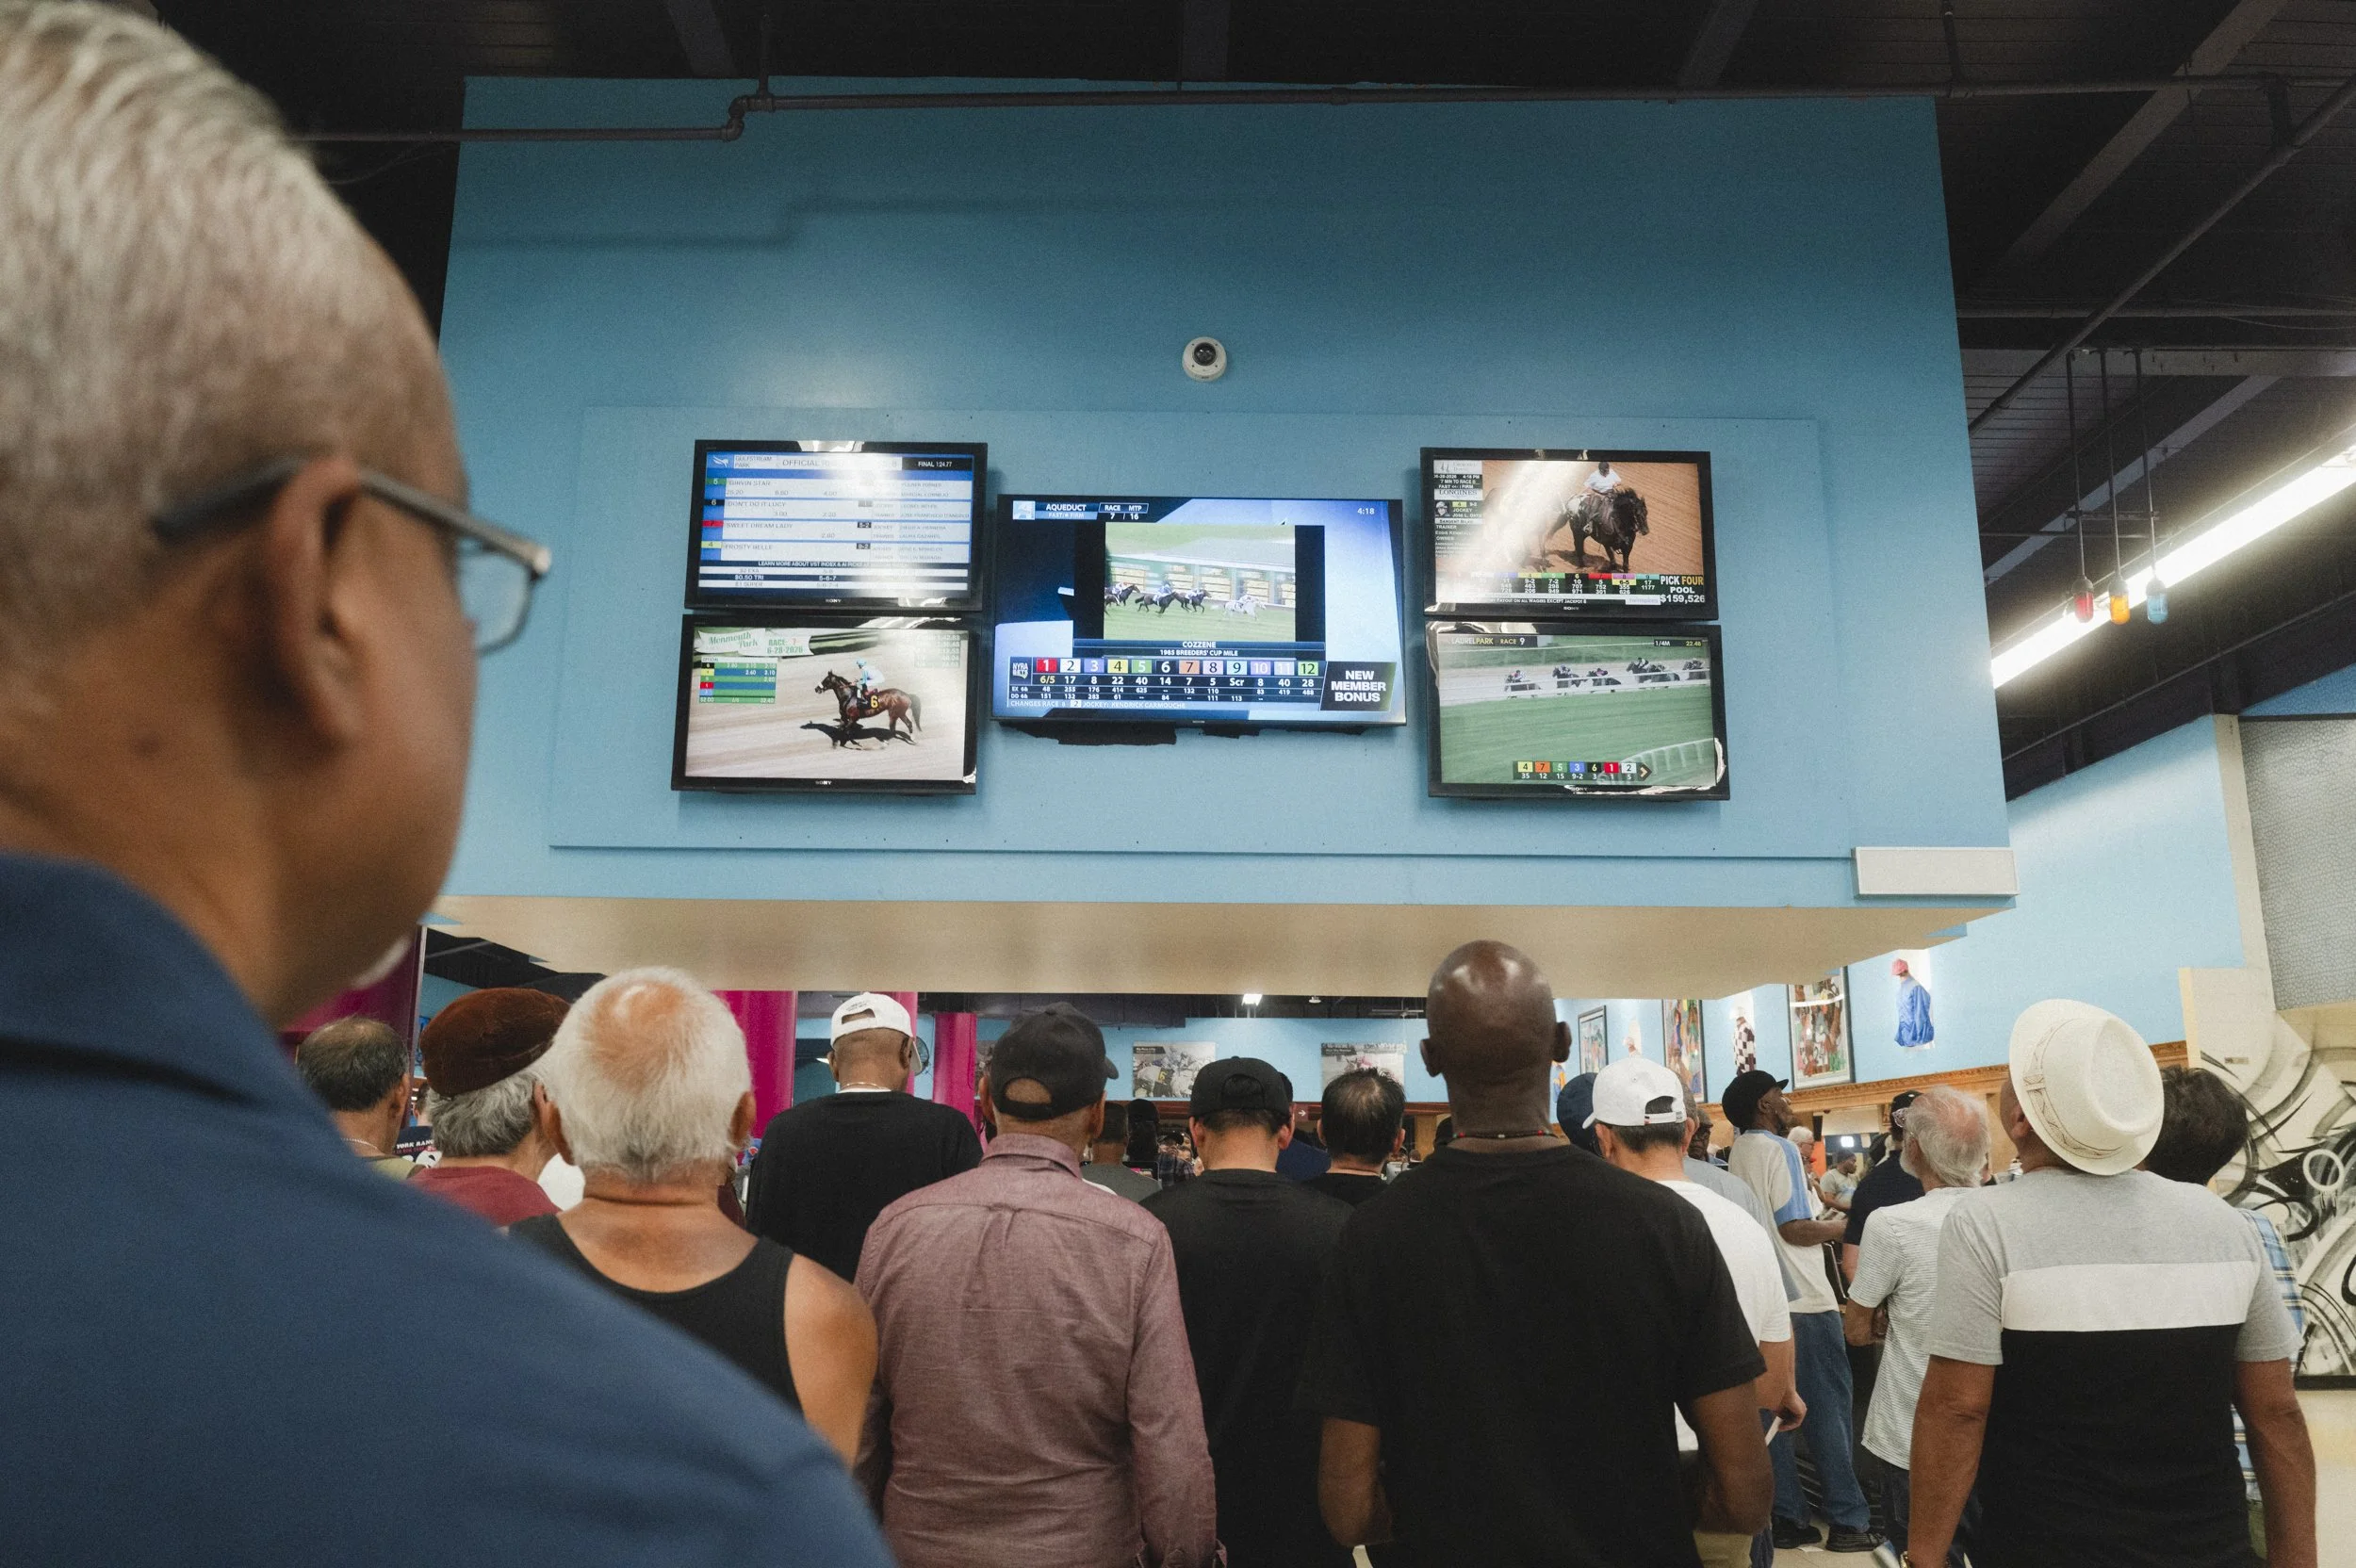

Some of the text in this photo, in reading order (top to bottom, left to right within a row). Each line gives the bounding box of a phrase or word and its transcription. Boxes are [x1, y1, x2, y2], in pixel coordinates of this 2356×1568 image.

[1045, 503, 1087, 512] AQUEDUCT
[1660, 575, 1704, 585] PICK FOUR
[1660, 595, 1706, 604] $159,526
[1519, 637, 1525, 645] 9
[1043, 660, 1315, 674] 1 2 3 4 5 6 7 8 9 10 11 12
[1345, 670, 1375, 680] NEW
[1039, 676, 1055, 684] 6/5
[1064, 676, 1076, 684] 17
[1111, 677, 1124, 685] 22
[1136, 677, 1148, 685] 40
[1159, 677, 1171, 685] 14
[1186, 678, 1192, 686] 7
[1210, 678, 1216, 686] 5
[1229, 678, 1244, 686] Scr
[1257, 678, 1264, 687] 8
[1278, 678, 1291, 687] 40
[1301, 678, 1315, 688] 28
[1331, 681, 1386, 692] MEMBER
[870, 694, 879, 709] 6
[1334, 692, 1381, 702] BONUS
